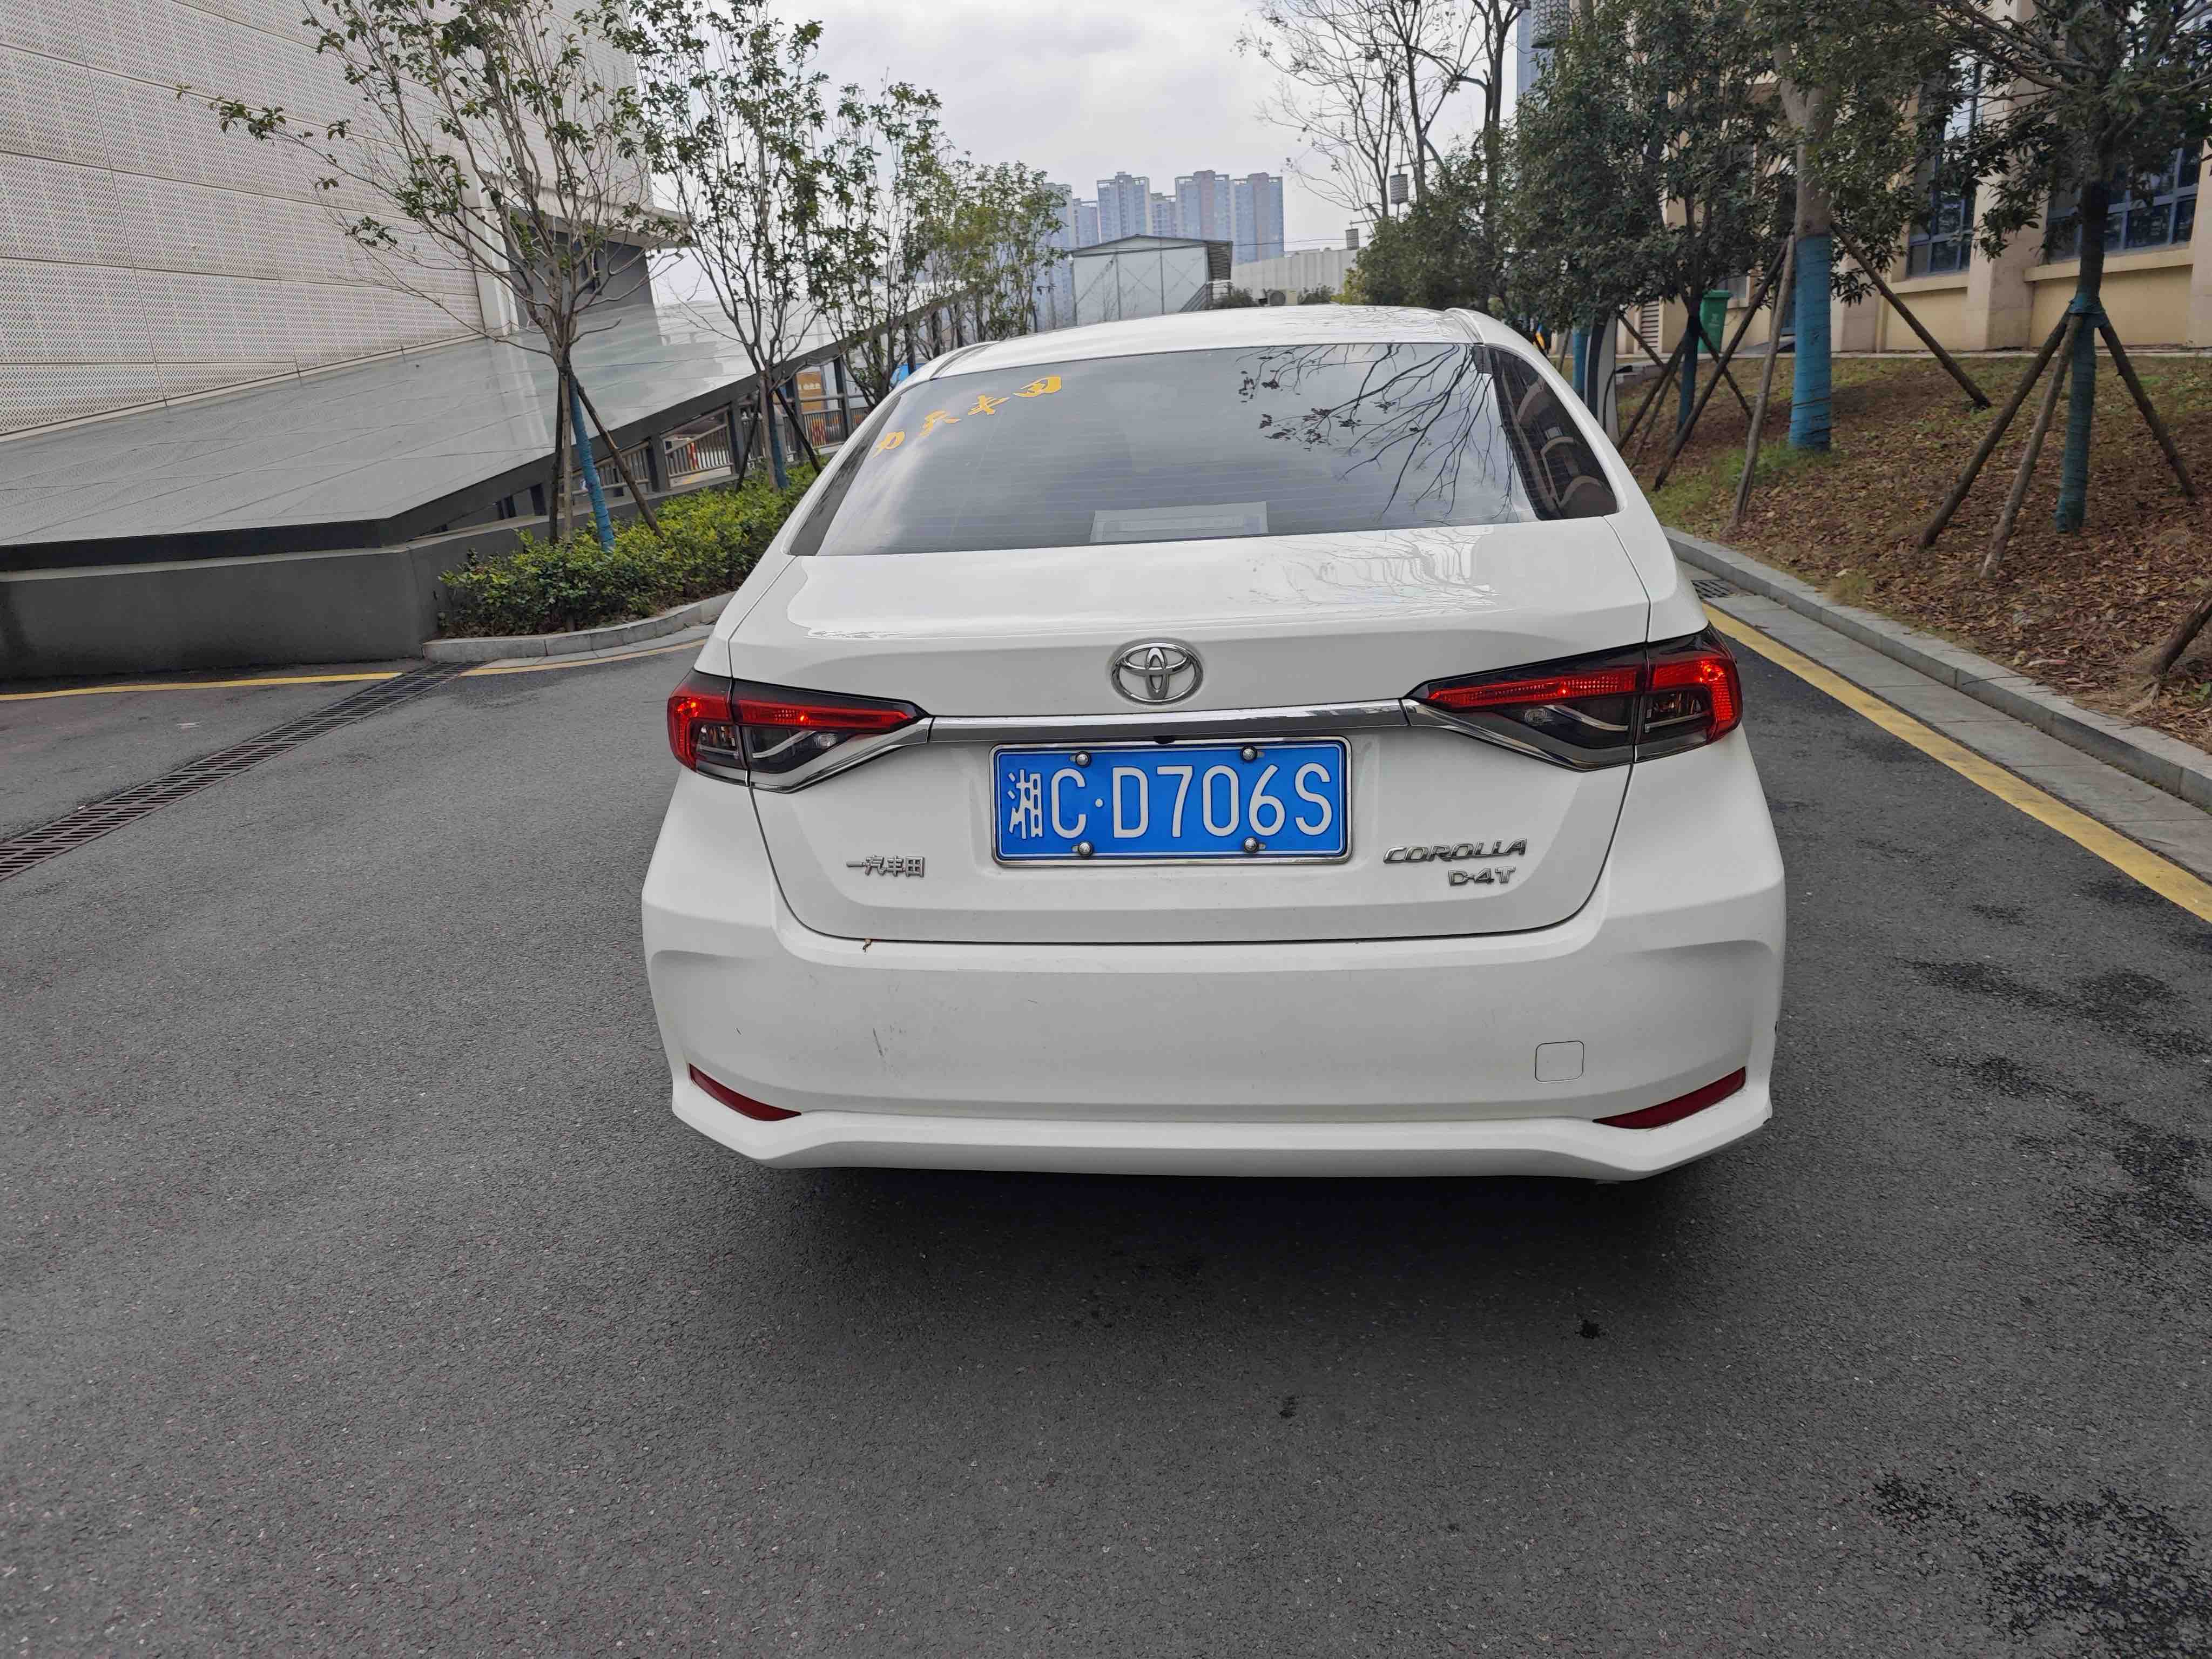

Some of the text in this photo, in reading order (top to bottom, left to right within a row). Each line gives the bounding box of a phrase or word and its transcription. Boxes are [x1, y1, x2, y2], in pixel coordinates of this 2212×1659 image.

[1382, 838, 1528, 865] COROLLA
[846, 855, 925, 878] 一汽丰田
[1447, 865, 1516, 886] D-4T
